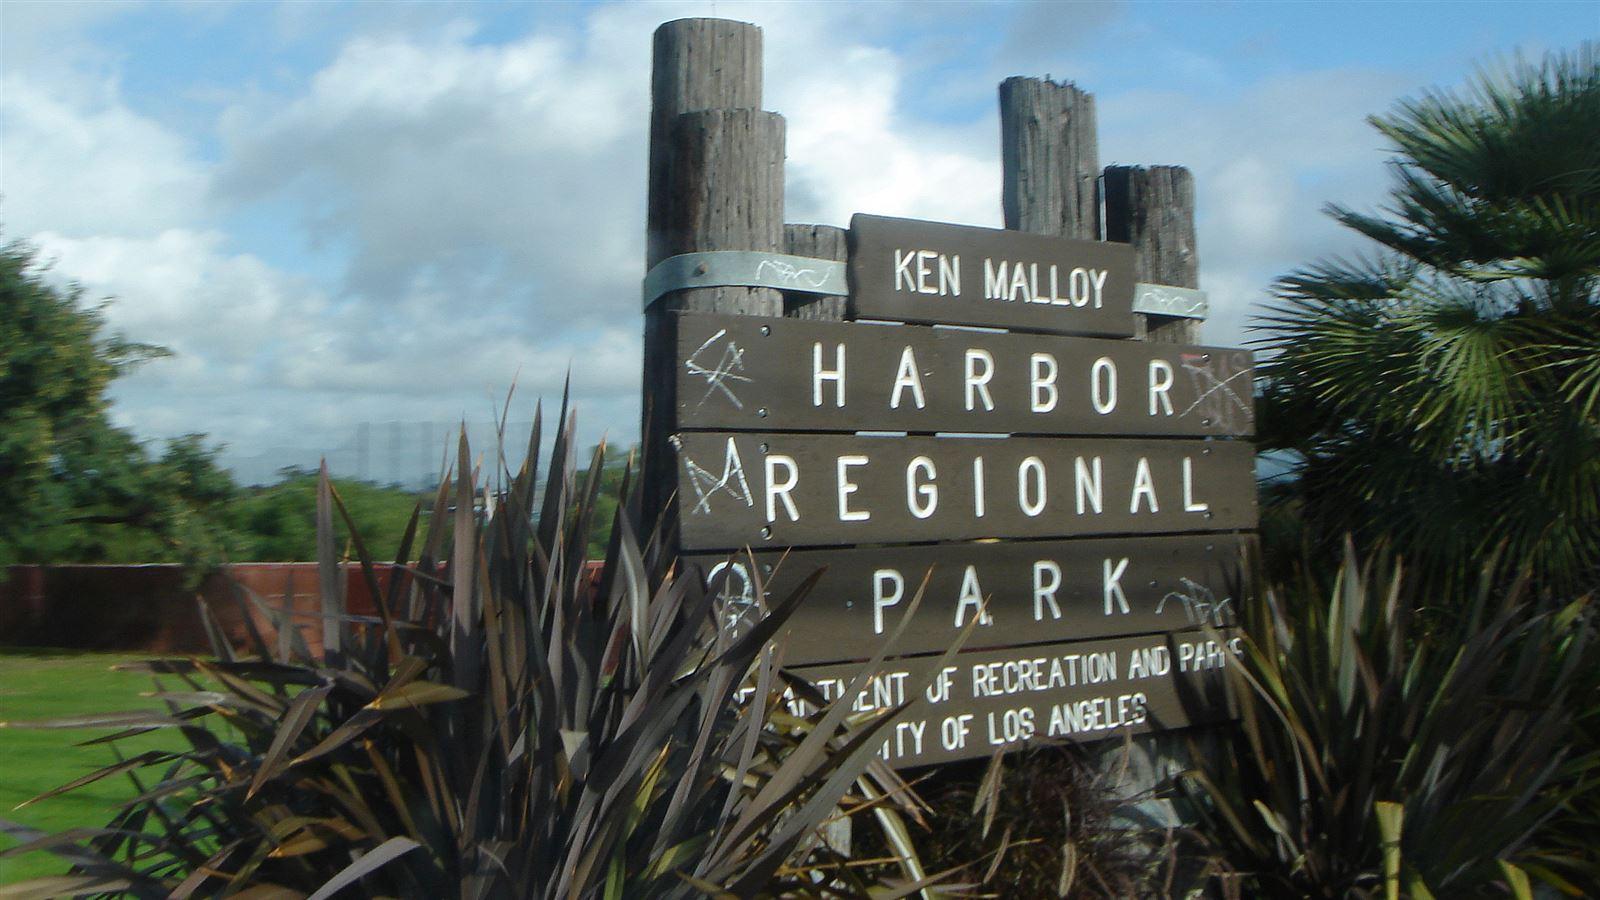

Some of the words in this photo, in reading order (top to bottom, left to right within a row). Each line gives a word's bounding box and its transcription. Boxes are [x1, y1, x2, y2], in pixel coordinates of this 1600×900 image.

[894, 249, 961, 297] KEN
[984, 257, 1108, 309] MALLOY
[813, 341, 1175, 417] HARBOR
[764, 454, 1209, 523] REGIONAL
[873, 556, 1131, 635] PARK
[926, 666, 958, 704] OF
[972, 651, 1118, 697] RECREATION
[1128, 645, 1171, 680] AND
[941, 713, 974, 751] OF
[987, 706, 1036, 746] LOS
[1048, 692, 1148, 737] ANGELES
